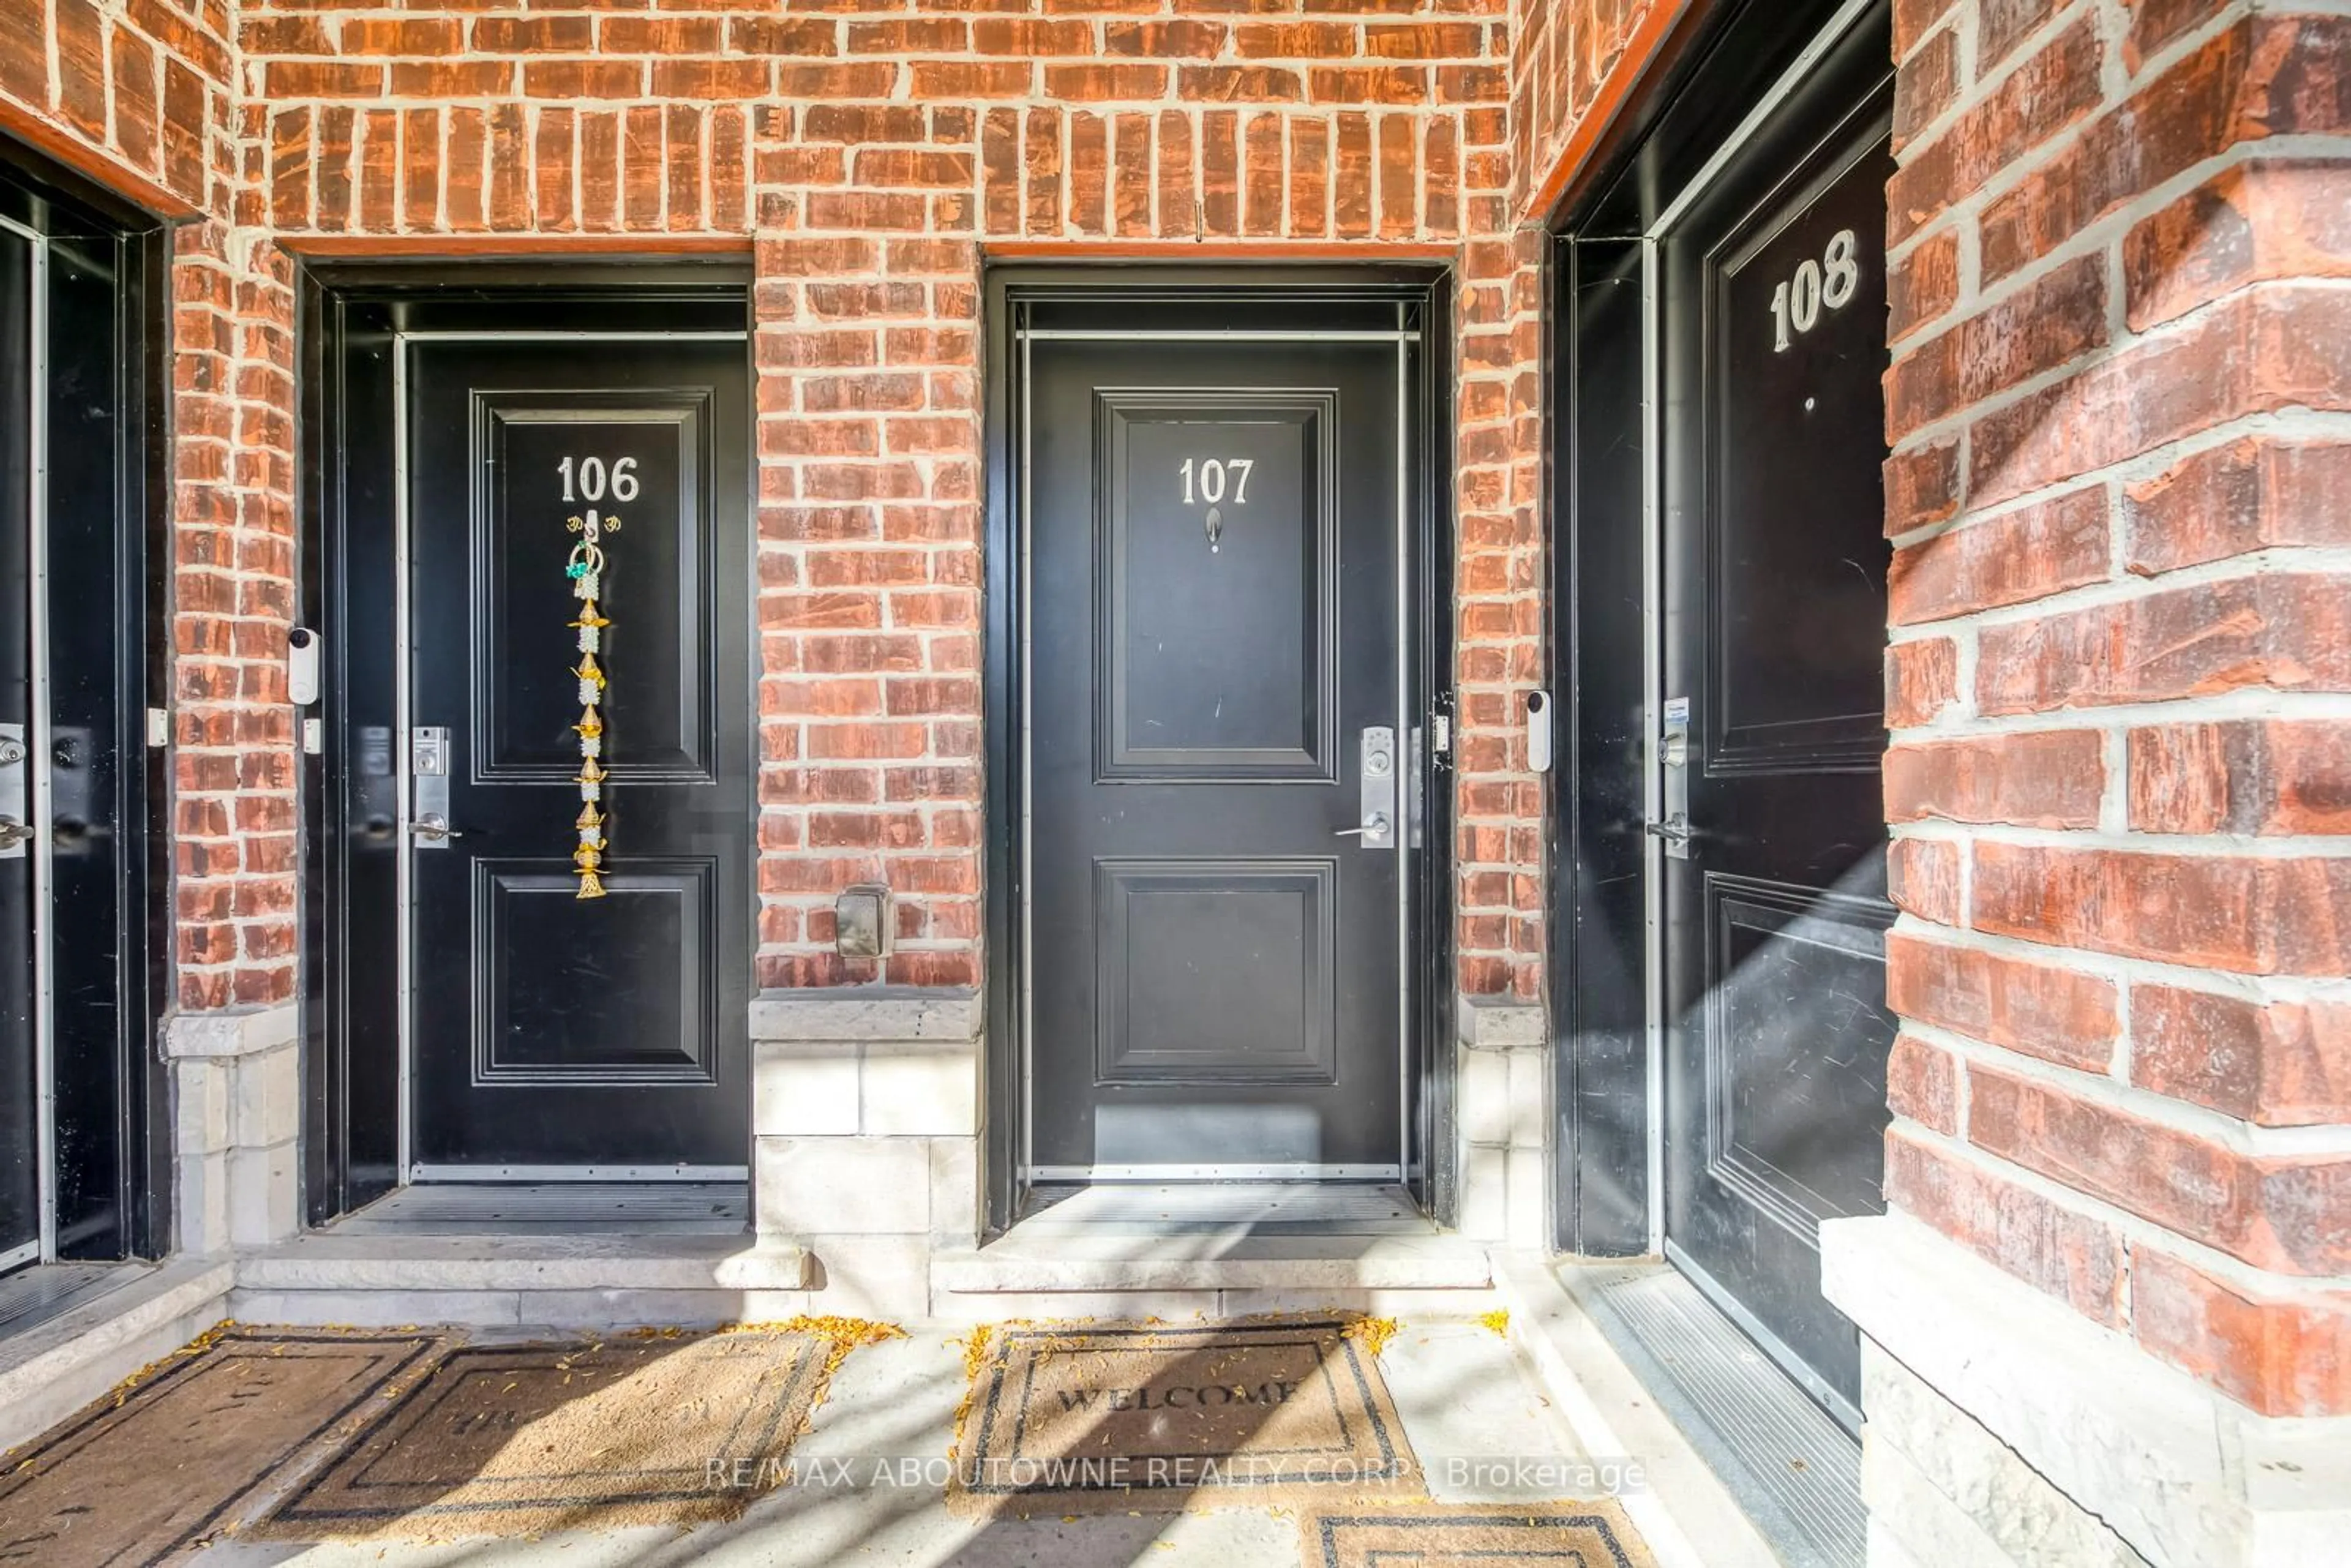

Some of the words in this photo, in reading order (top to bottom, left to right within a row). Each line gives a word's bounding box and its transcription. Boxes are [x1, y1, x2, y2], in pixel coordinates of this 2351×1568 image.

[1769, 228, 1859, 353] 108
[557, 456, 640, 502] 106
[1179, 458, 1254, 505] 107
[1057, 1381, 1300, 1411] WELCOME
